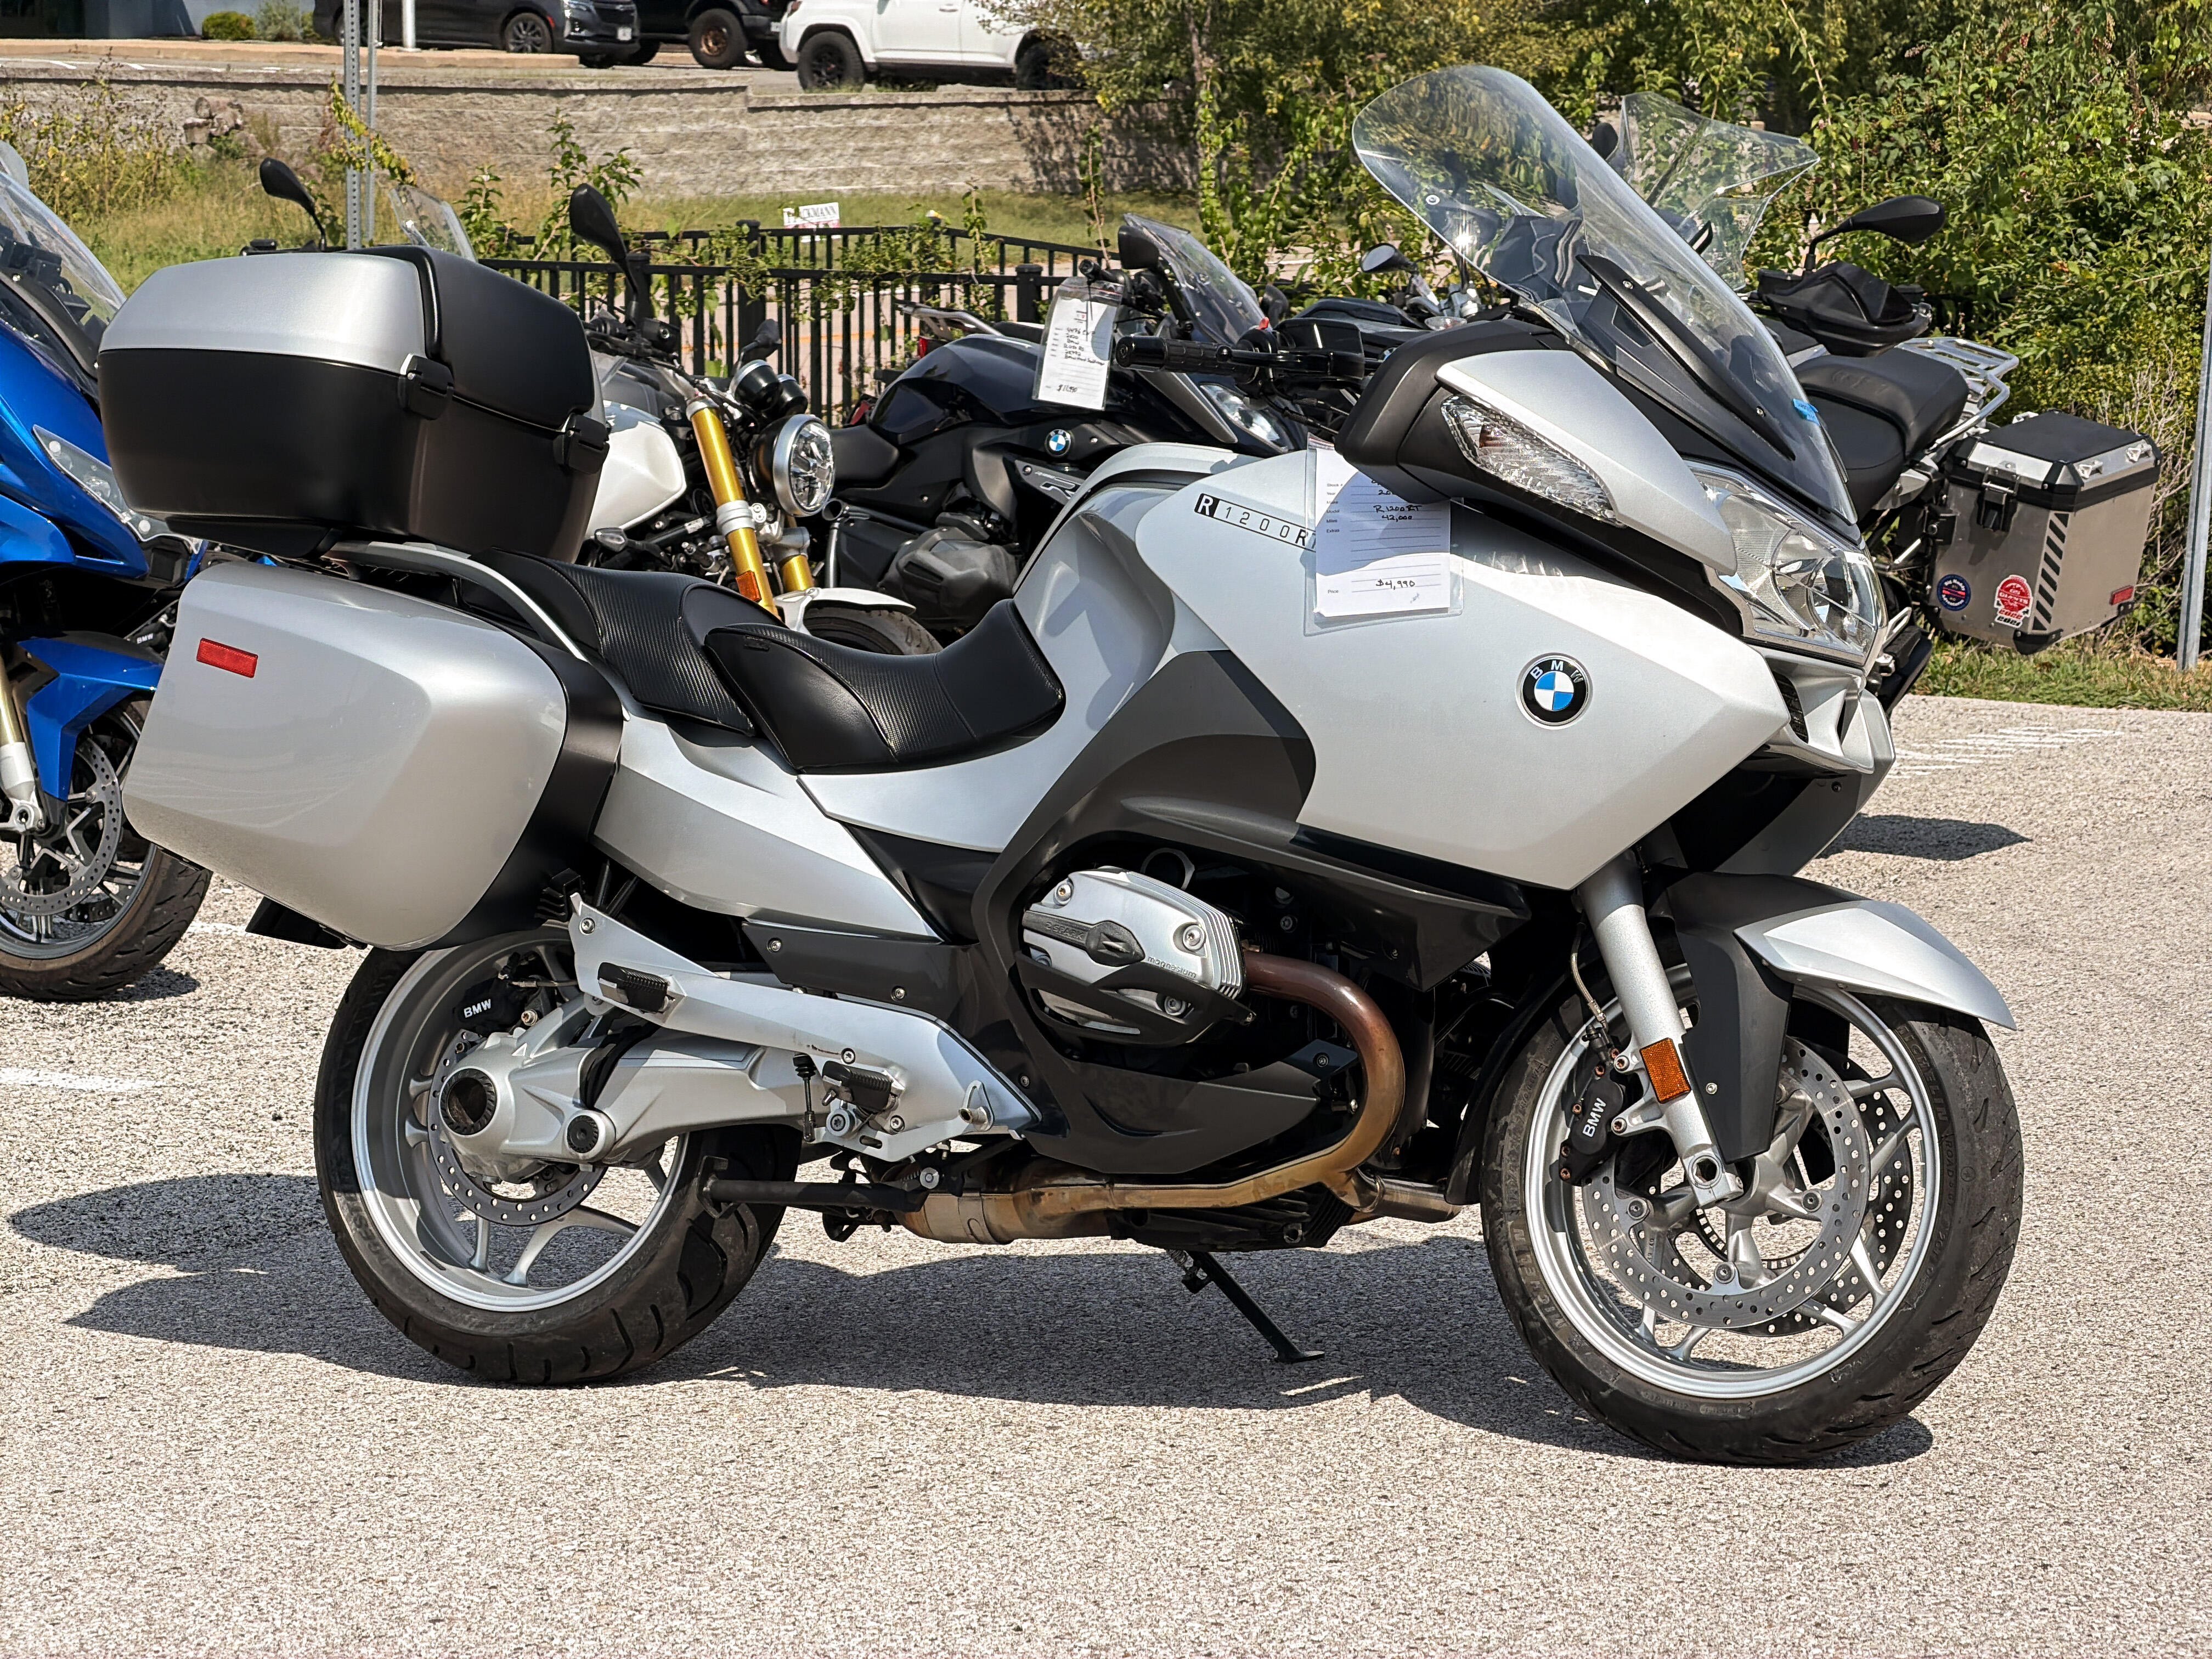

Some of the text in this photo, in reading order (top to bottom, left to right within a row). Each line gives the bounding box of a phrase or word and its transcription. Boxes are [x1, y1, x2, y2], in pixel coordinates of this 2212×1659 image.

[1376, 579, 1415, 590] $4,990
[137, 633, 154, 644] BMW
[1530, 660, 1584, 684] BMW
[1052, 924, 1085, 940] SPARK
[1147, 956, 1197, 979] magnesium
[464, 998, 491, 1018] BMW
[1582, 1097, 1606, 1137] BMW
[1945, 1140, 1954, 1177] ROAD
